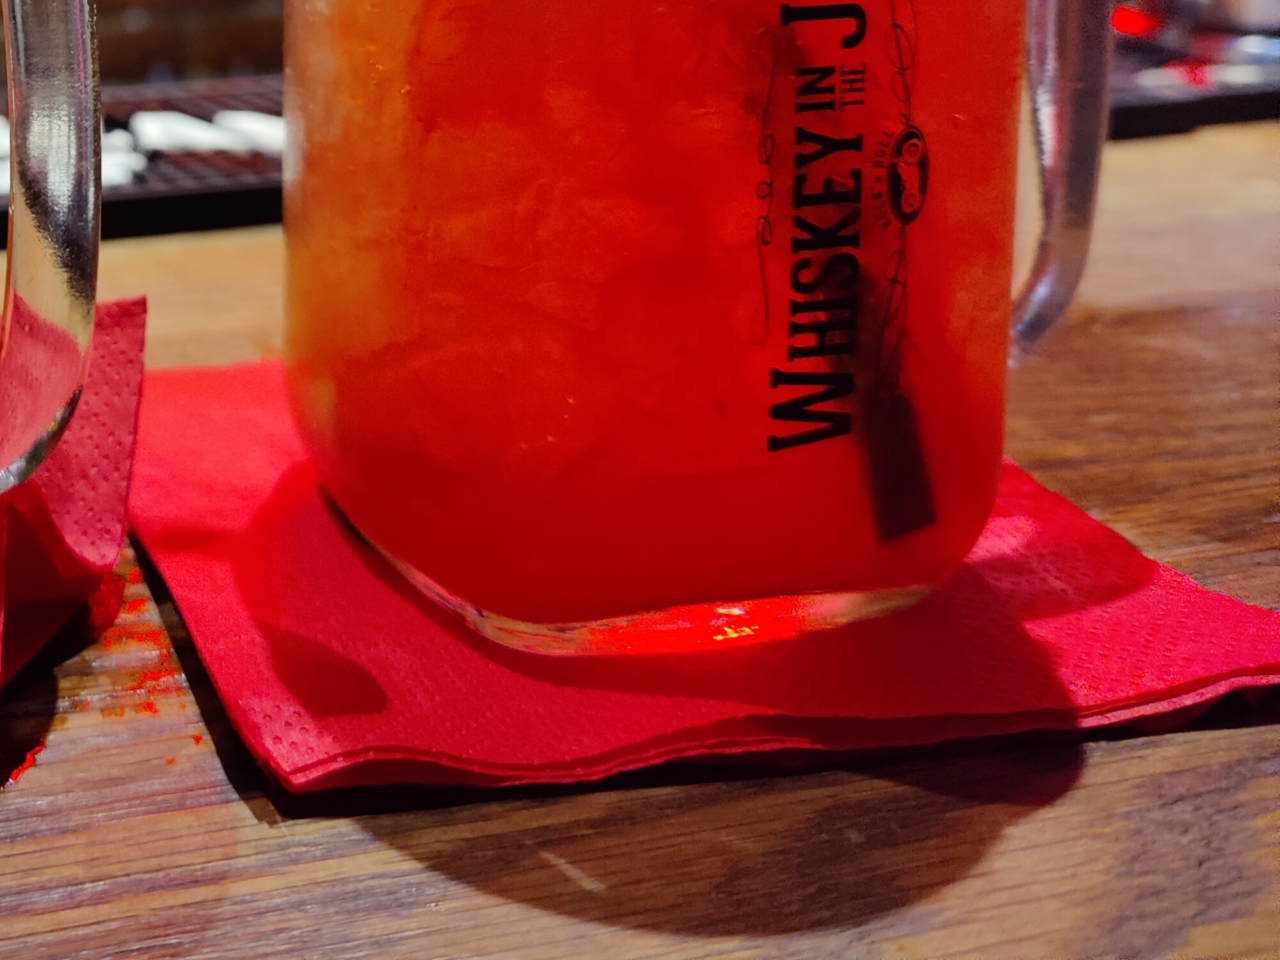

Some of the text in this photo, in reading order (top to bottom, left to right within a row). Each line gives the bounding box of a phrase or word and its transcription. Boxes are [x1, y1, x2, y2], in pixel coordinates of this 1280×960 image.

[795, 65, 836, 114] IN
[839, 62, 866, 112] THE
[767, 127, 863, 452] WHISKEY
